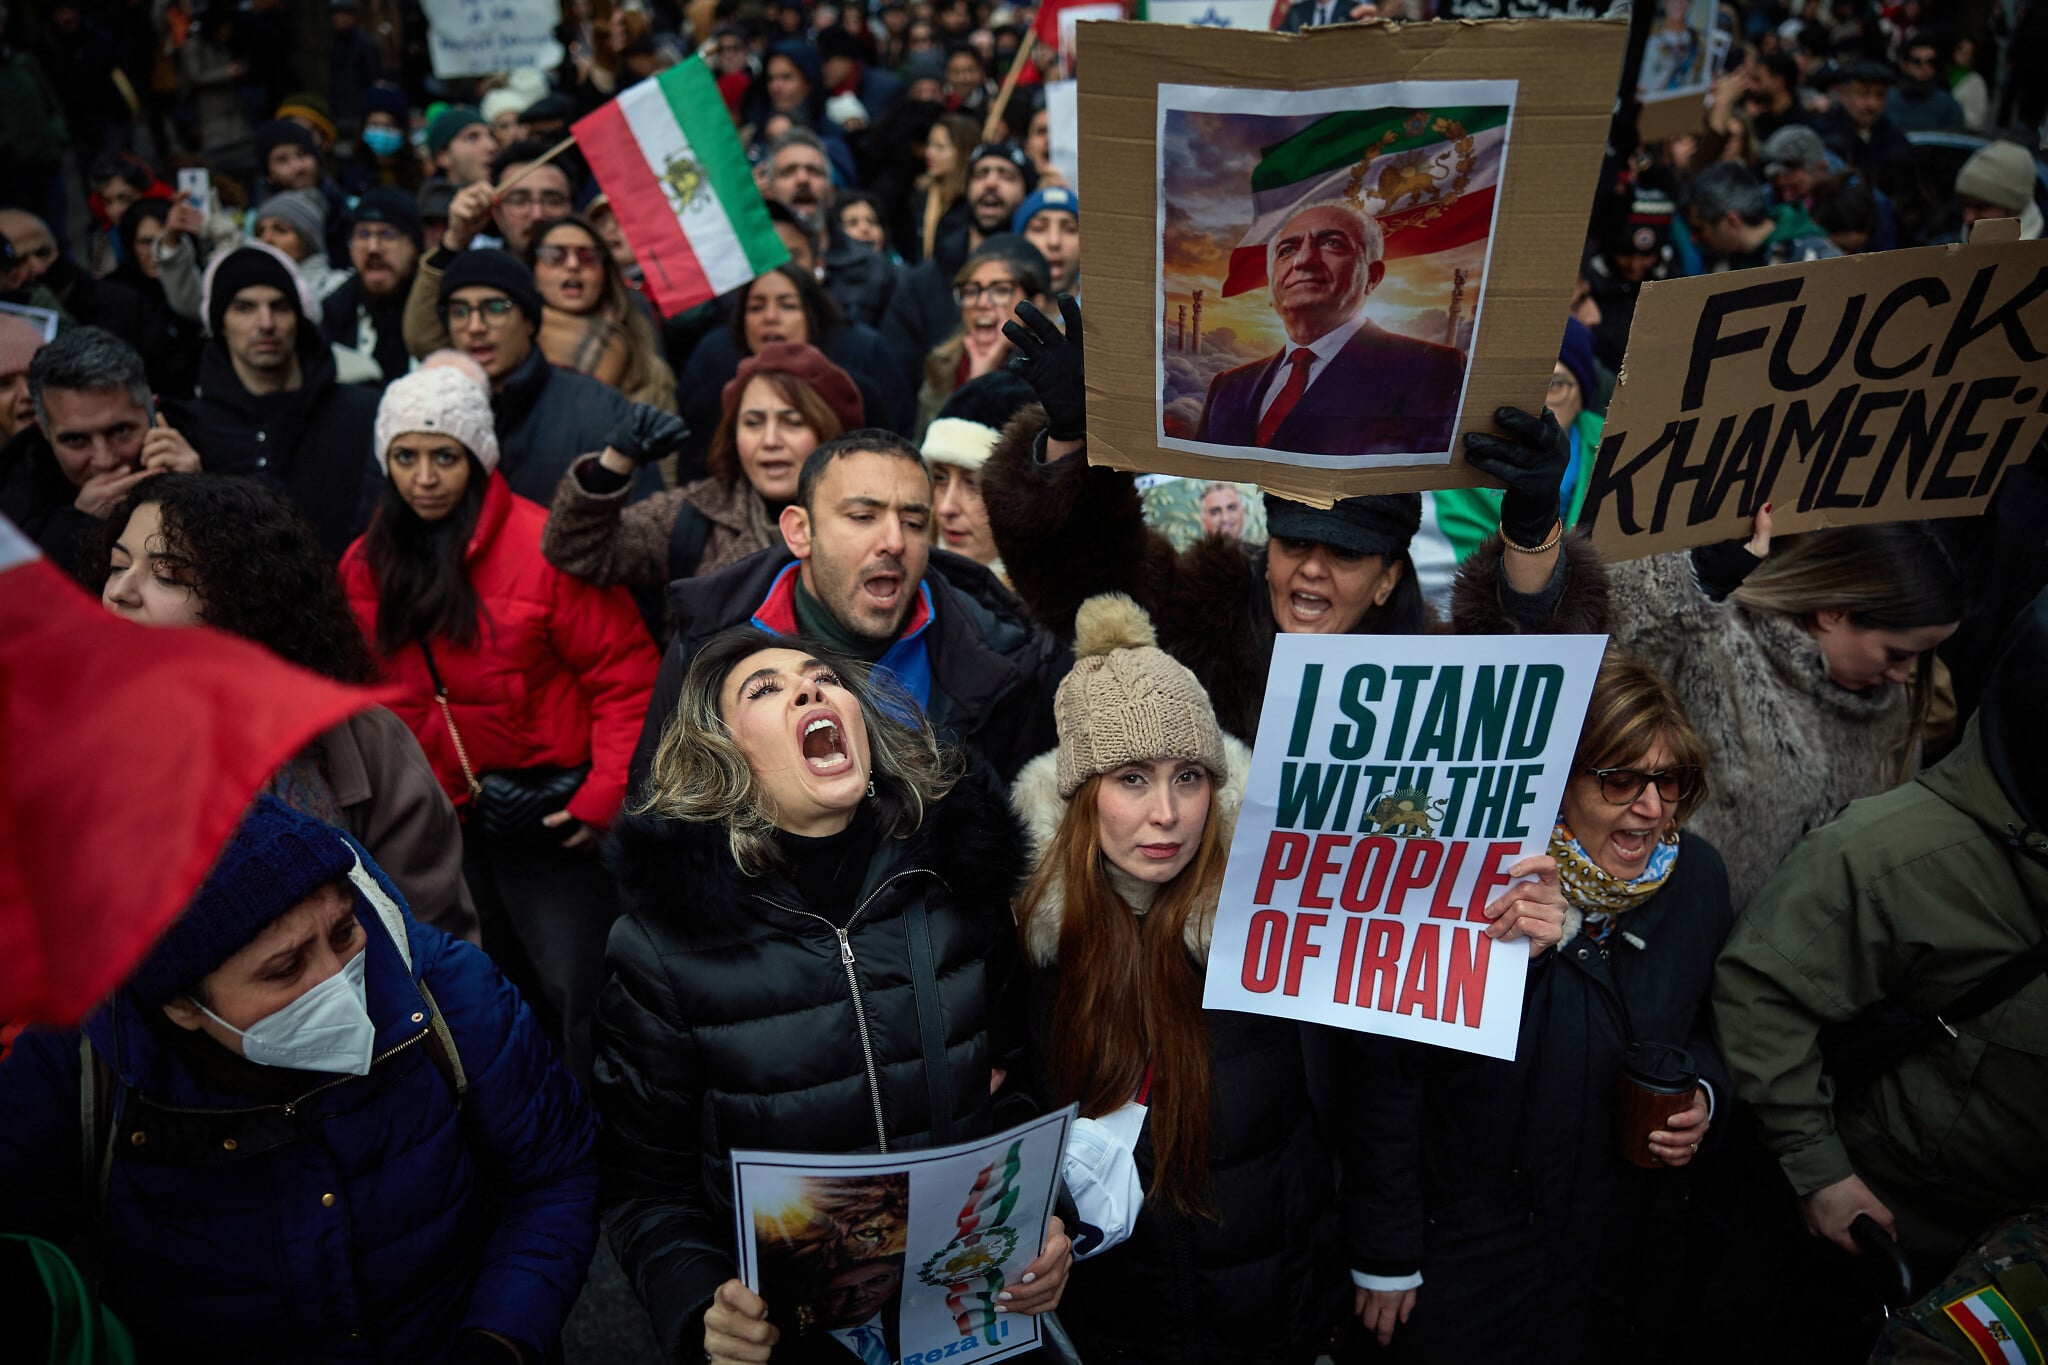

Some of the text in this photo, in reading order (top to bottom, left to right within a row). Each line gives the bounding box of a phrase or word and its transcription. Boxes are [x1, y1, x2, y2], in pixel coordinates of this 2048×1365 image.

[1681, 264, 2048, 412] FUCK
[1286, 663, 1564, 762] I STAND
[1275, 762, 1545, 838] WITH THE
[1253, 830, 1523, 924] PEOPLE
[1240, 909, 1492, 1030] OF IRAN
[903, 1335, 980, 1365] Reza
